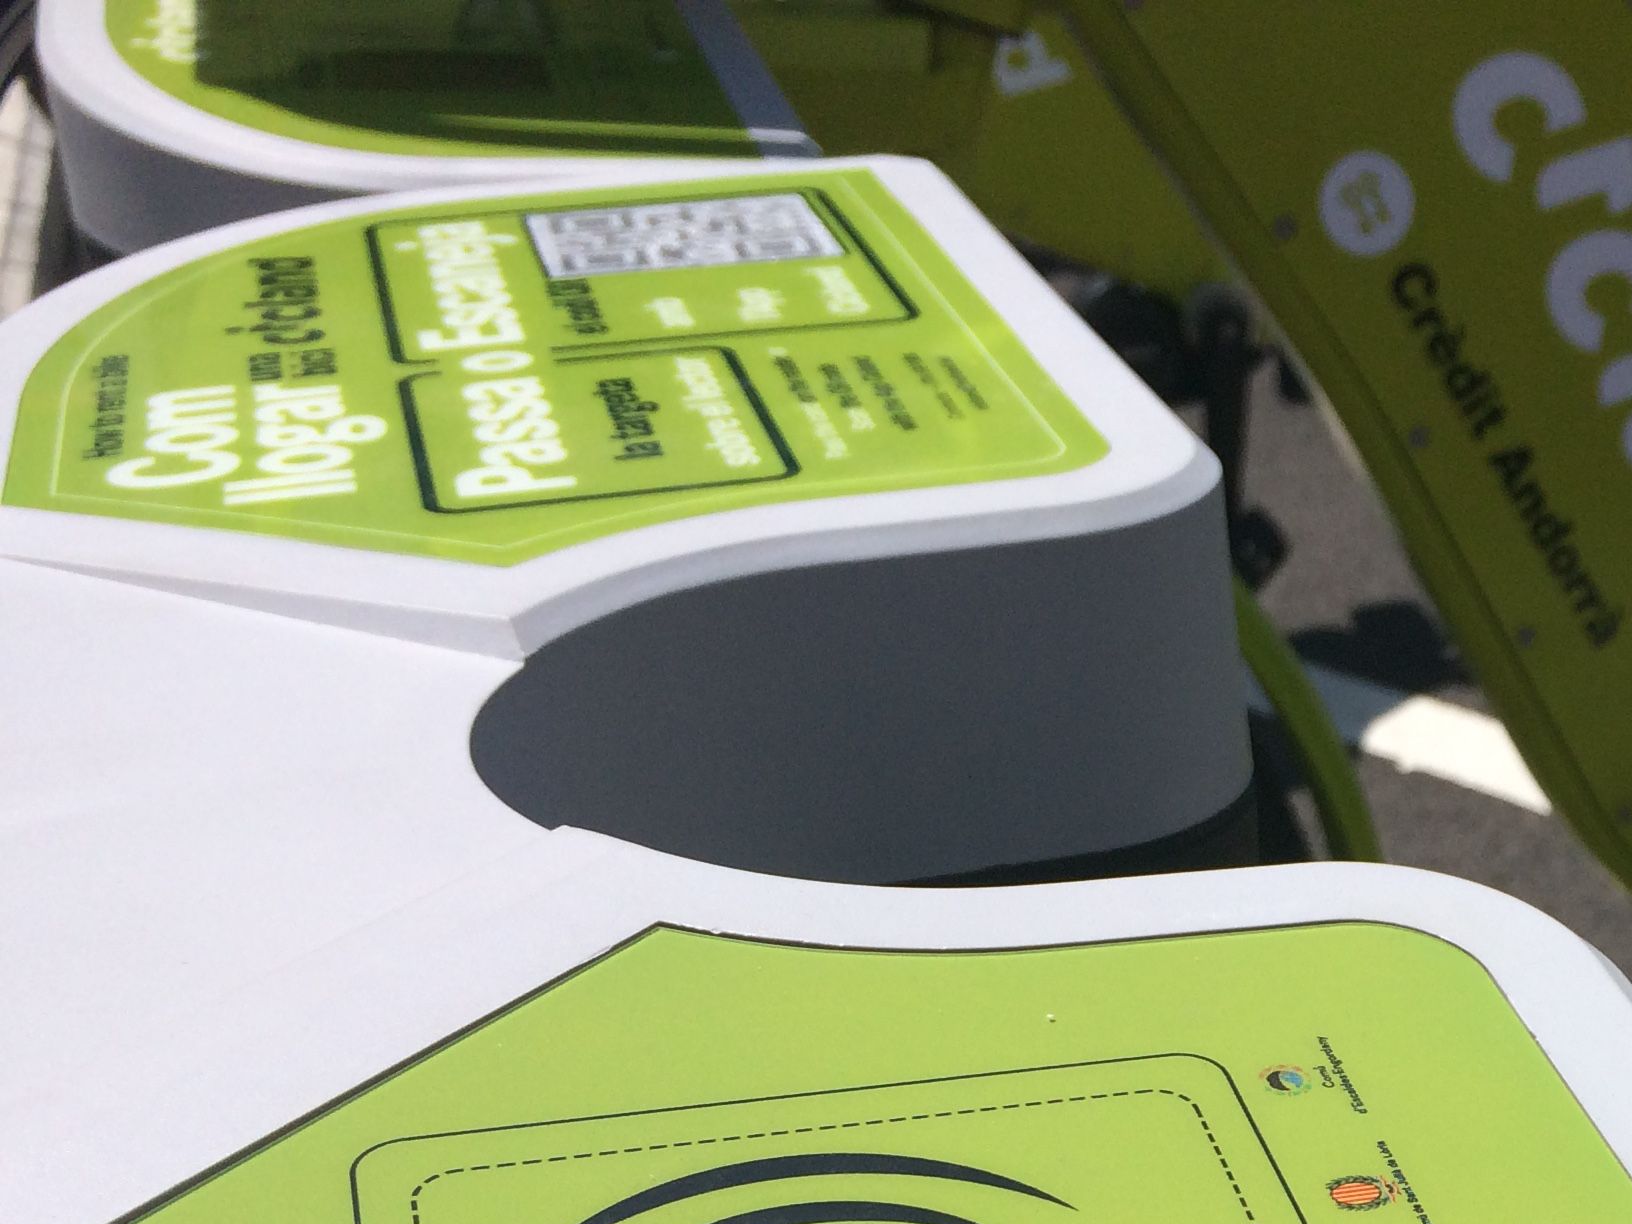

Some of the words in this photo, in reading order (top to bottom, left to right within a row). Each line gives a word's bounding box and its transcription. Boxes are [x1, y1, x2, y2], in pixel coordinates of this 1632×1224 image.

[394, 219, 527, 352] Escaneja
[459, 349, 535, 373] o
[591, 376, 661, 440] targeta
[104, 384, 241, 490] Com
[223, 384, 389, 506] llogar
[454, 376, 579, 499] Passa
[614, 439, 665, 462] la
[1312, 1065, 1335, 1088] Comú
[1387, 1159, 1398, 1168] de
[1412, 1204, 1424, 1213] de
